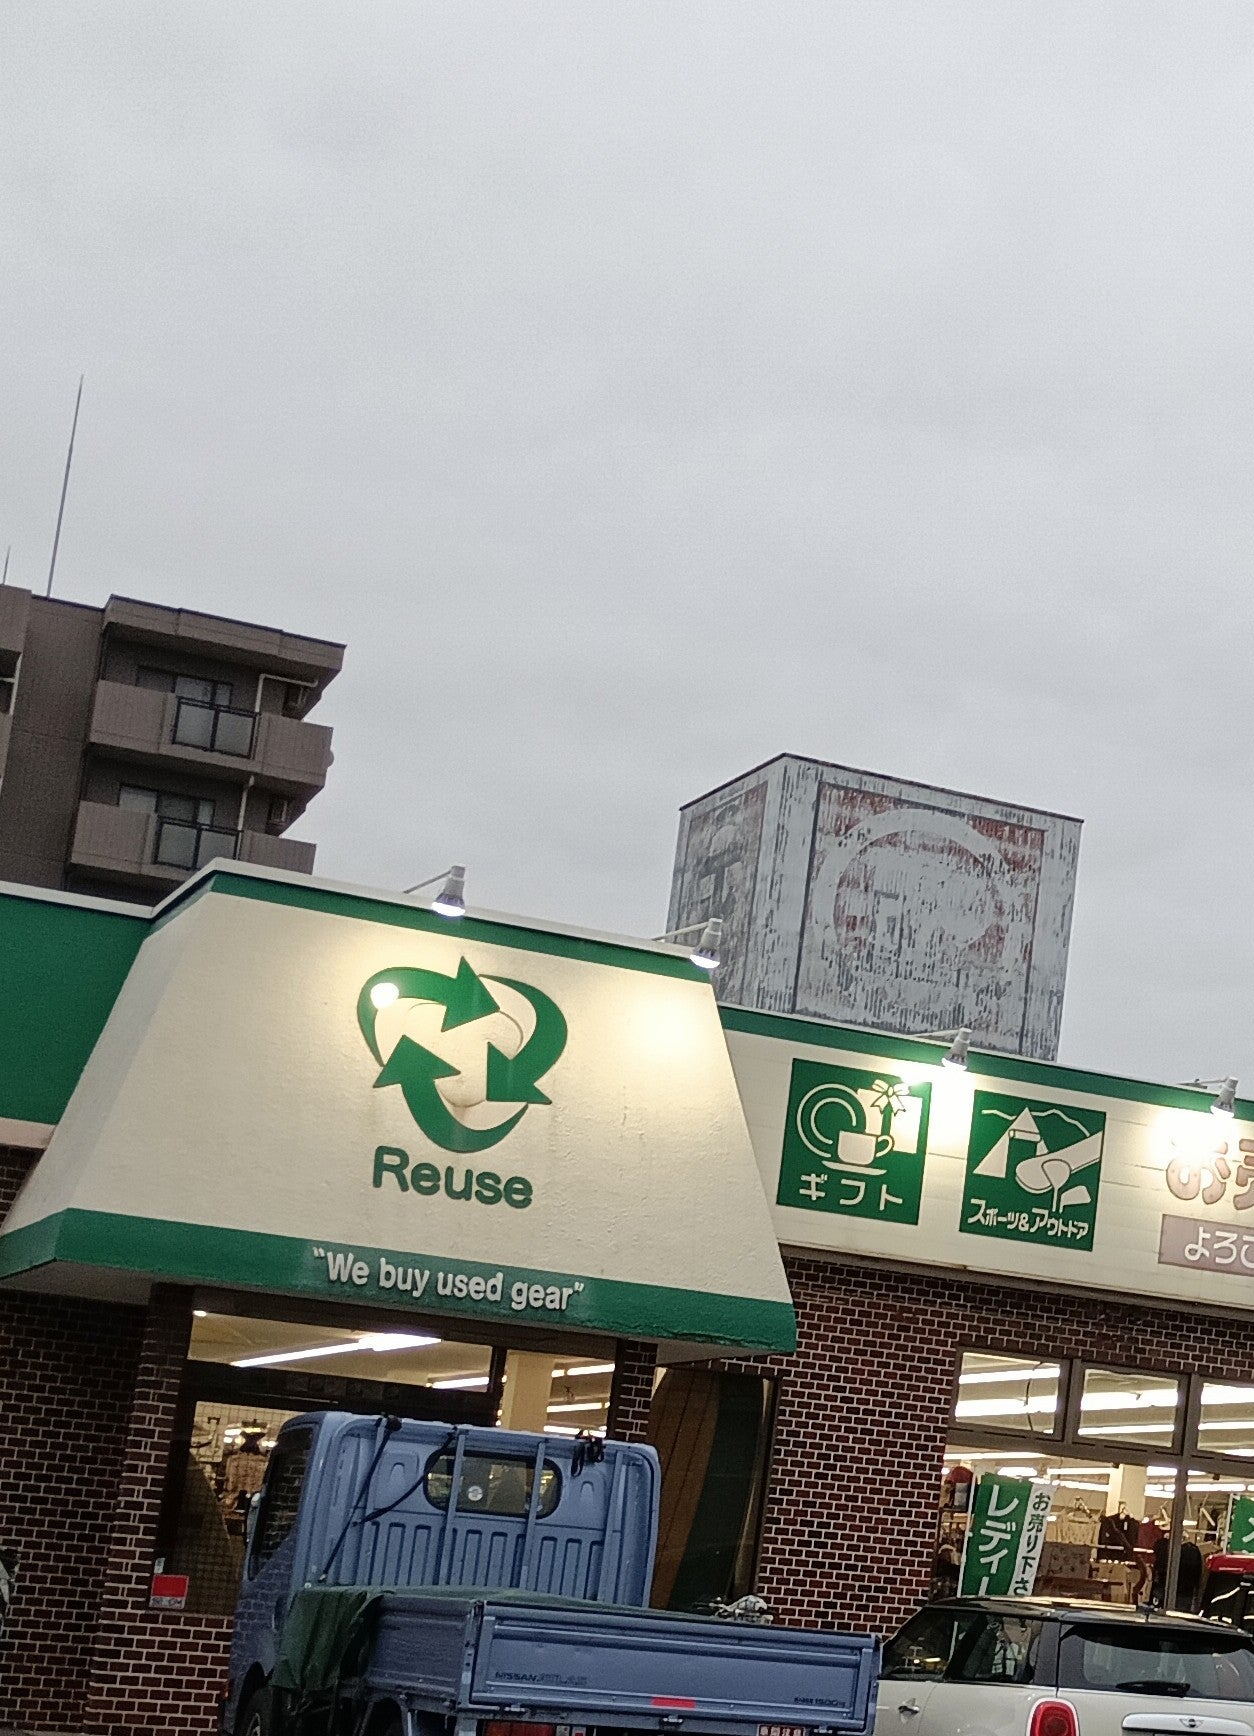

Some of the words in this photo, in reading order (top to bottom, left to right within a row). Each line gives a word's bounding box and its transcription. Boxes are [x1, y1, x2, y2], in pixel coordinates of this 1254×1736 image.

[373, 1145, 533, 1209] Reuse
[799, 1172, 903, 1211] ギフト
[379, 1257, 430, 1298] buy
[437, 1271, 504, 1302] used
